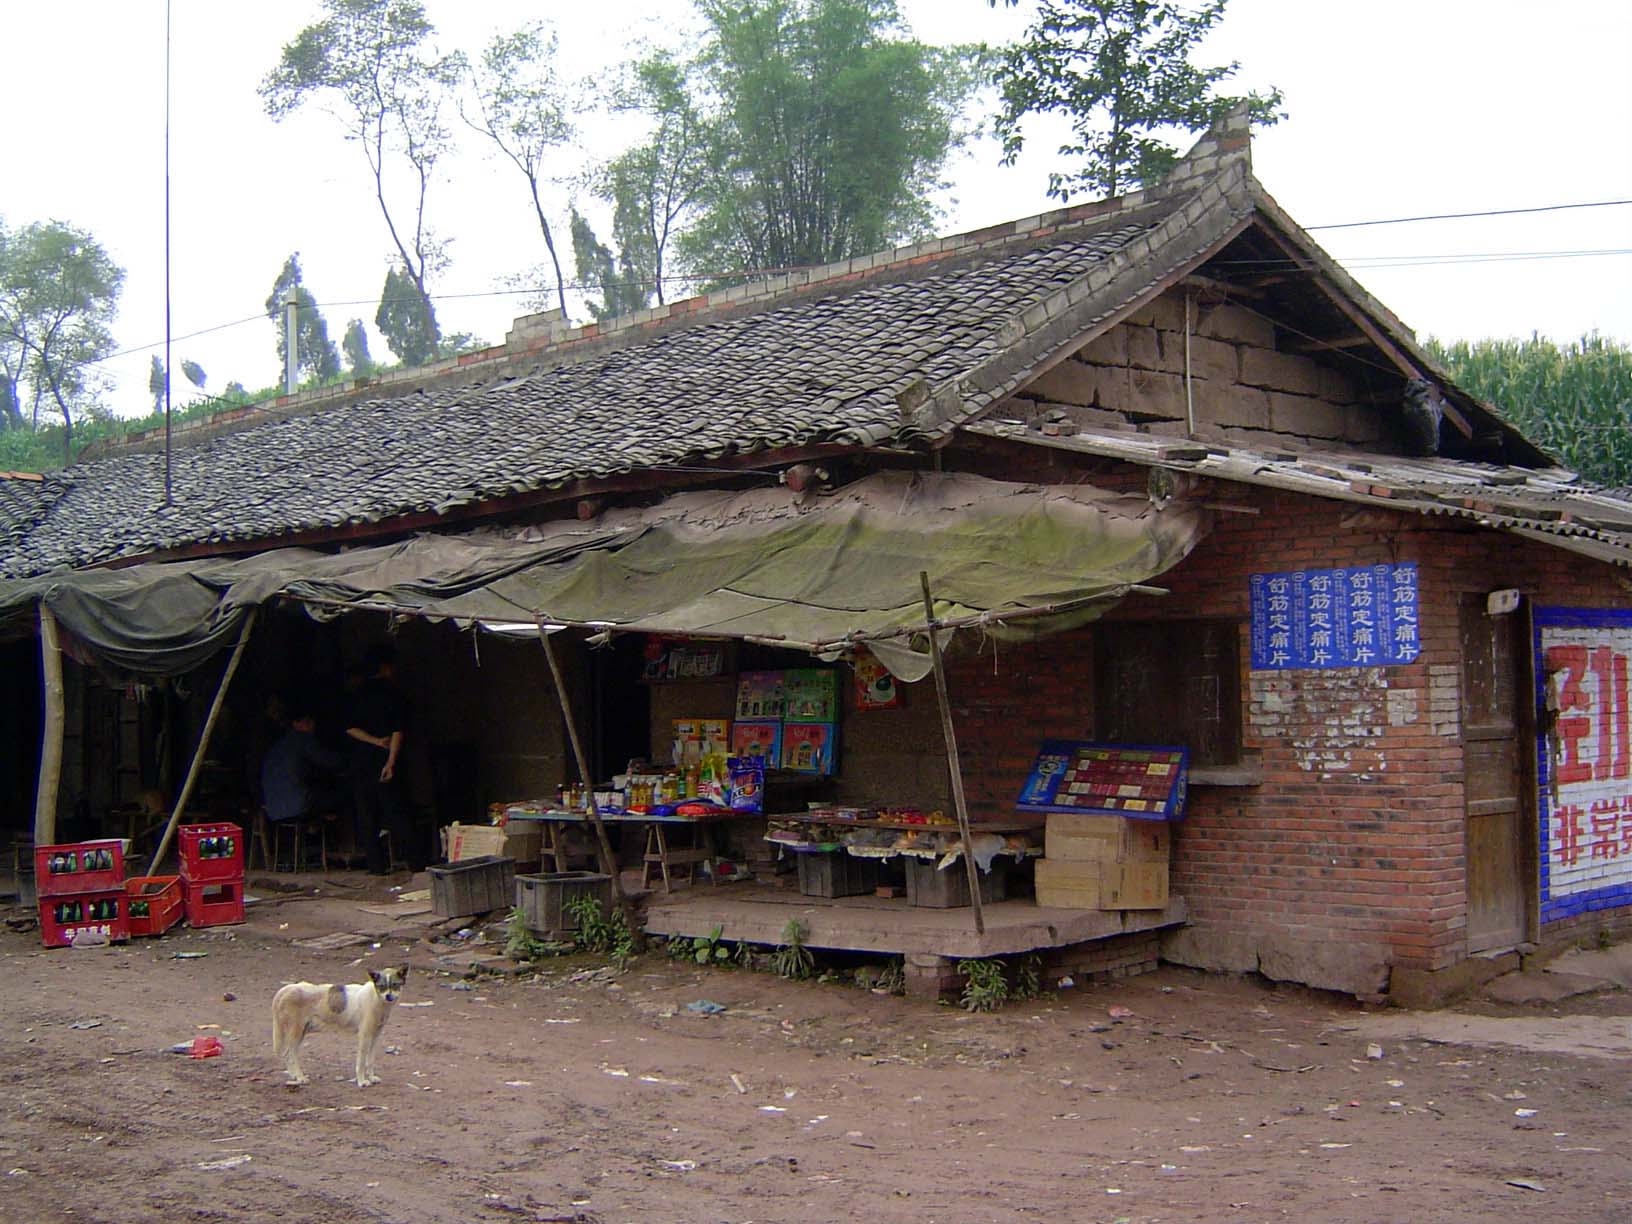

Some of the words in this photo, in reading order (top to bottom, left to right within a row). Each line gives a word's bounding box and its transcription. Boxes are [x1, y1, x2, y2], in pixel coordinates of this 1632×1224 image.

[1267, 578, 1291, 666] 舒筋定痛片
[1309, 575, 1333, 665] 舒筋定痛片
[1350, 572, 1376, 663] 舒筋定痛片
[1392, 567, 1419, 660] 舒筋定痛片
